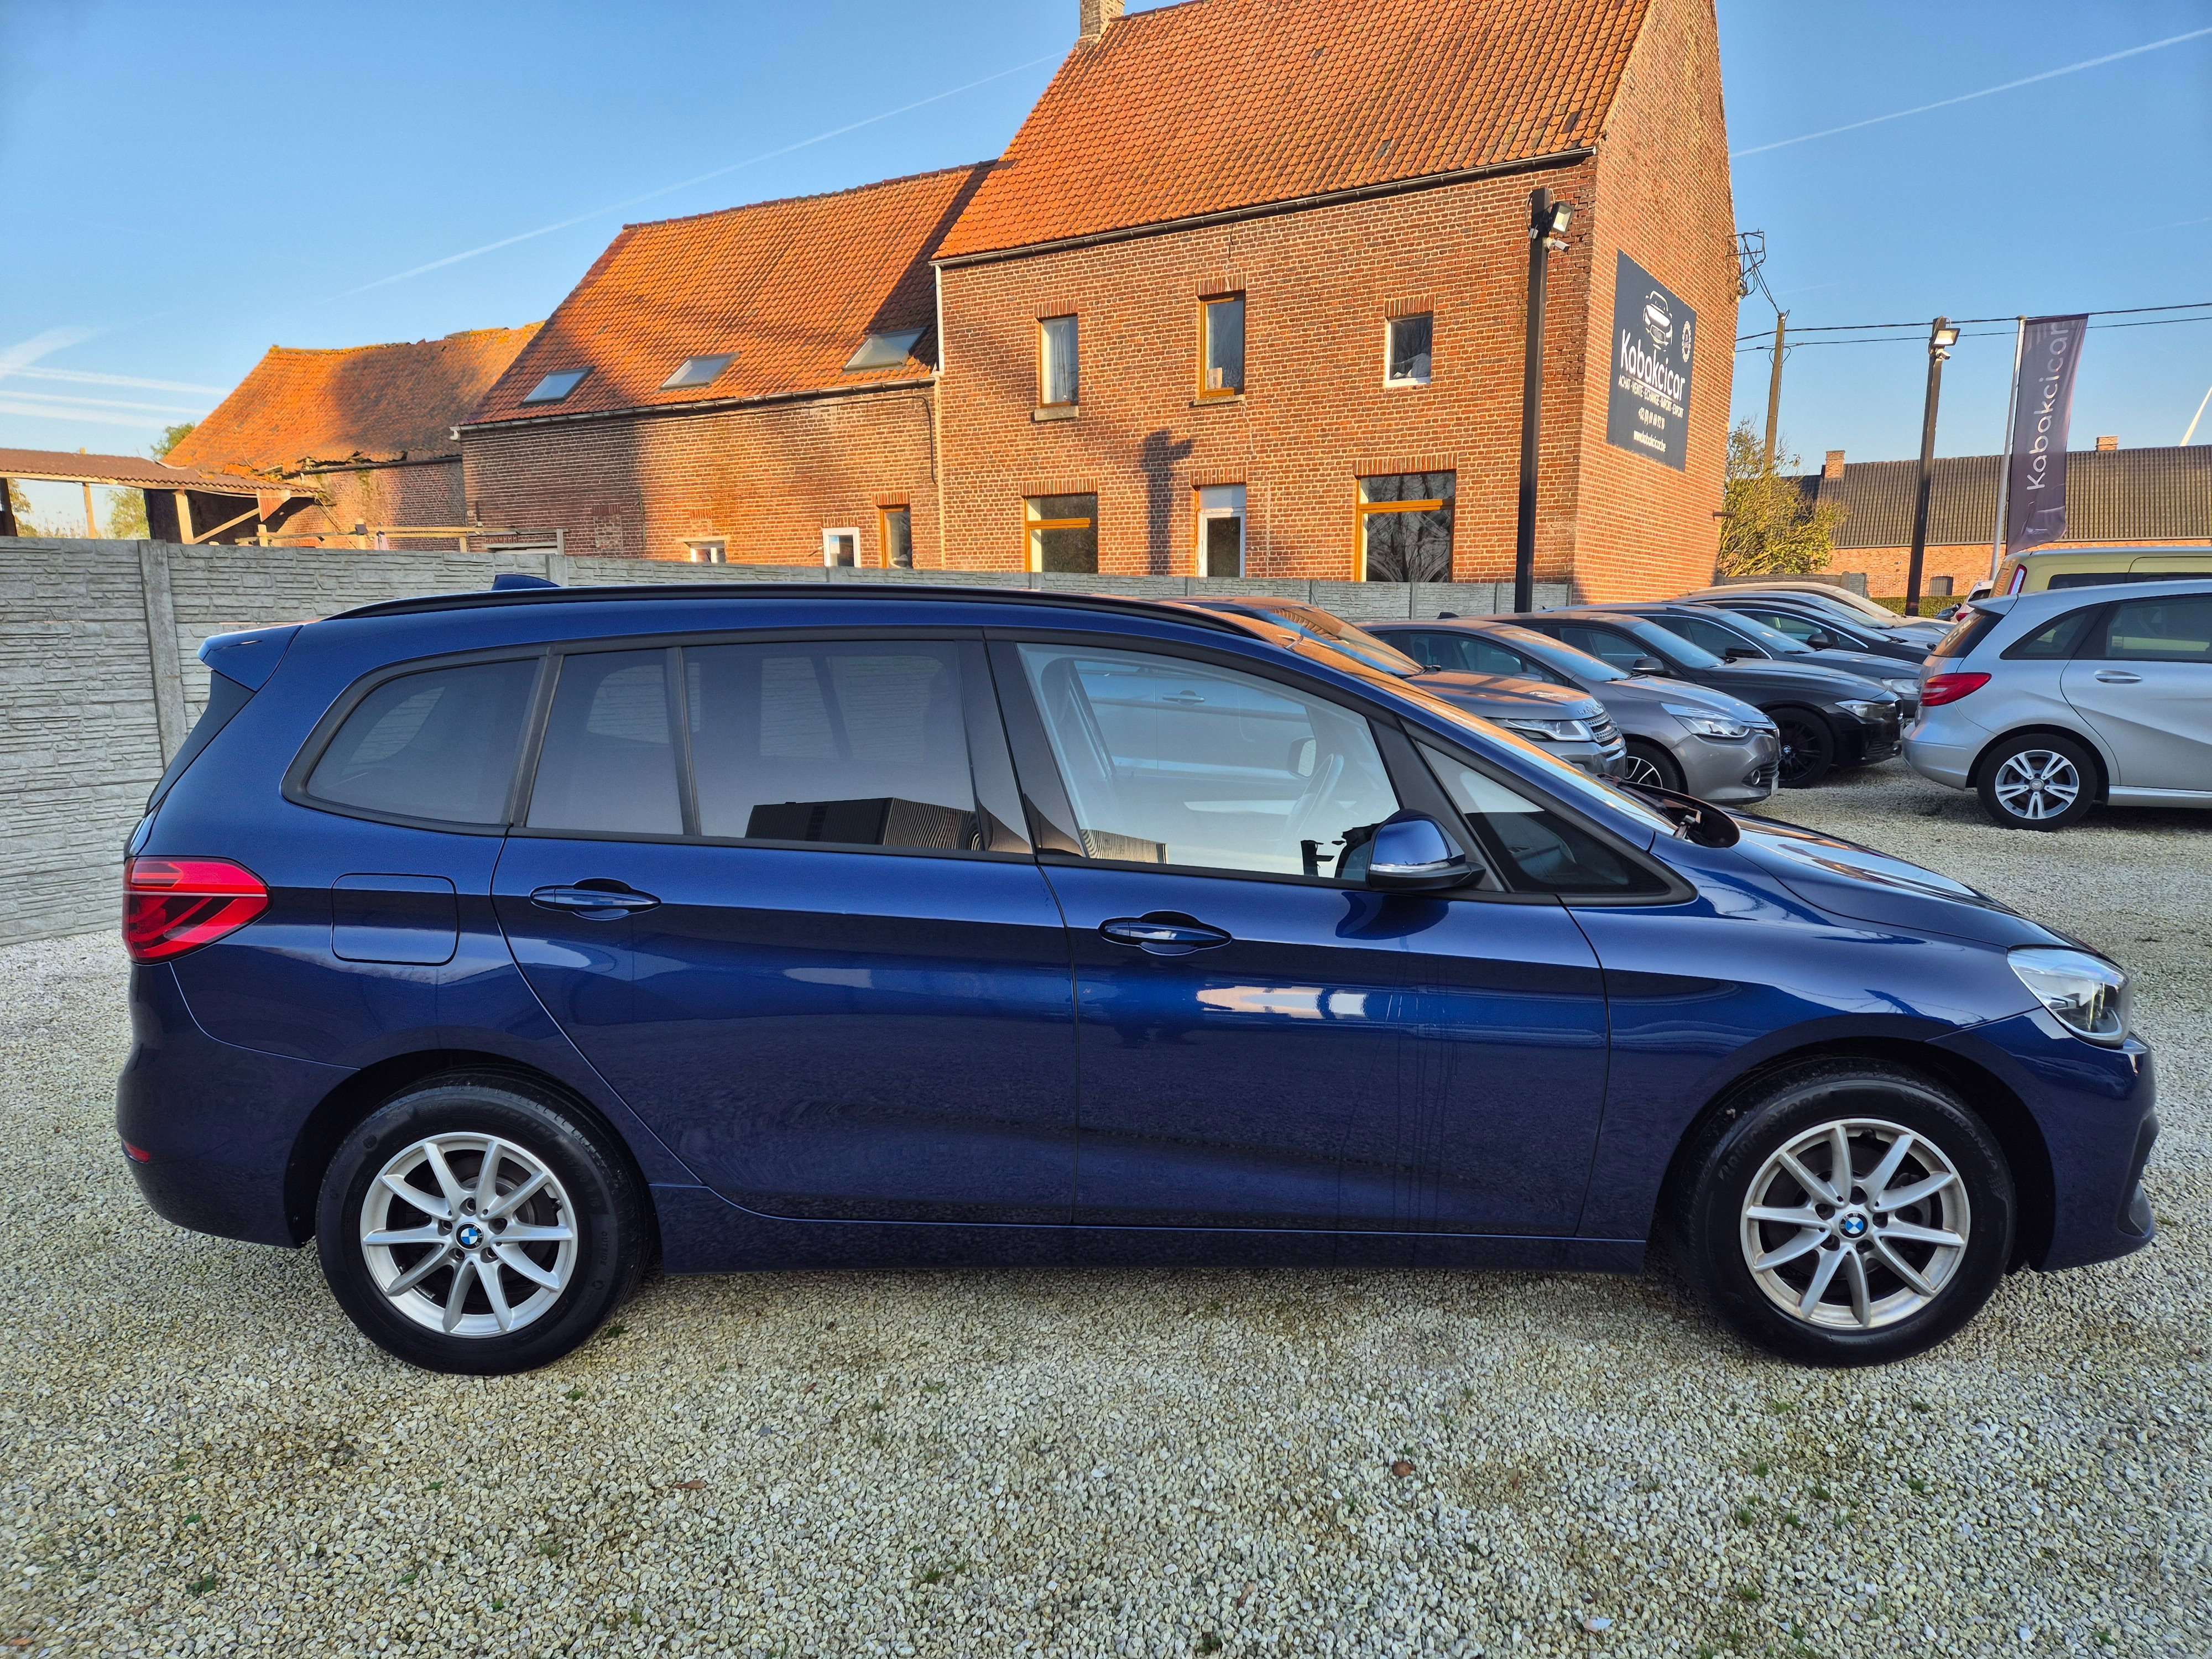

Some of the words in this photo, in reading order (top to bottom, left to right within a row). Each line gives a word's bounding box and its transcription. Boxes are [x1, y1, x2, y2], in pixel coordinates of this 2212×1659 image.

[1618, 374, 1631, 390] ACHAT
[1632, 380, 1644, 398] VENTE
[1672, 403, 1684, 418] EXPORT
[1620, 328, 1686, 401] Kabakcicar
[2027, 323, 2069, 490] Kabakcicar
